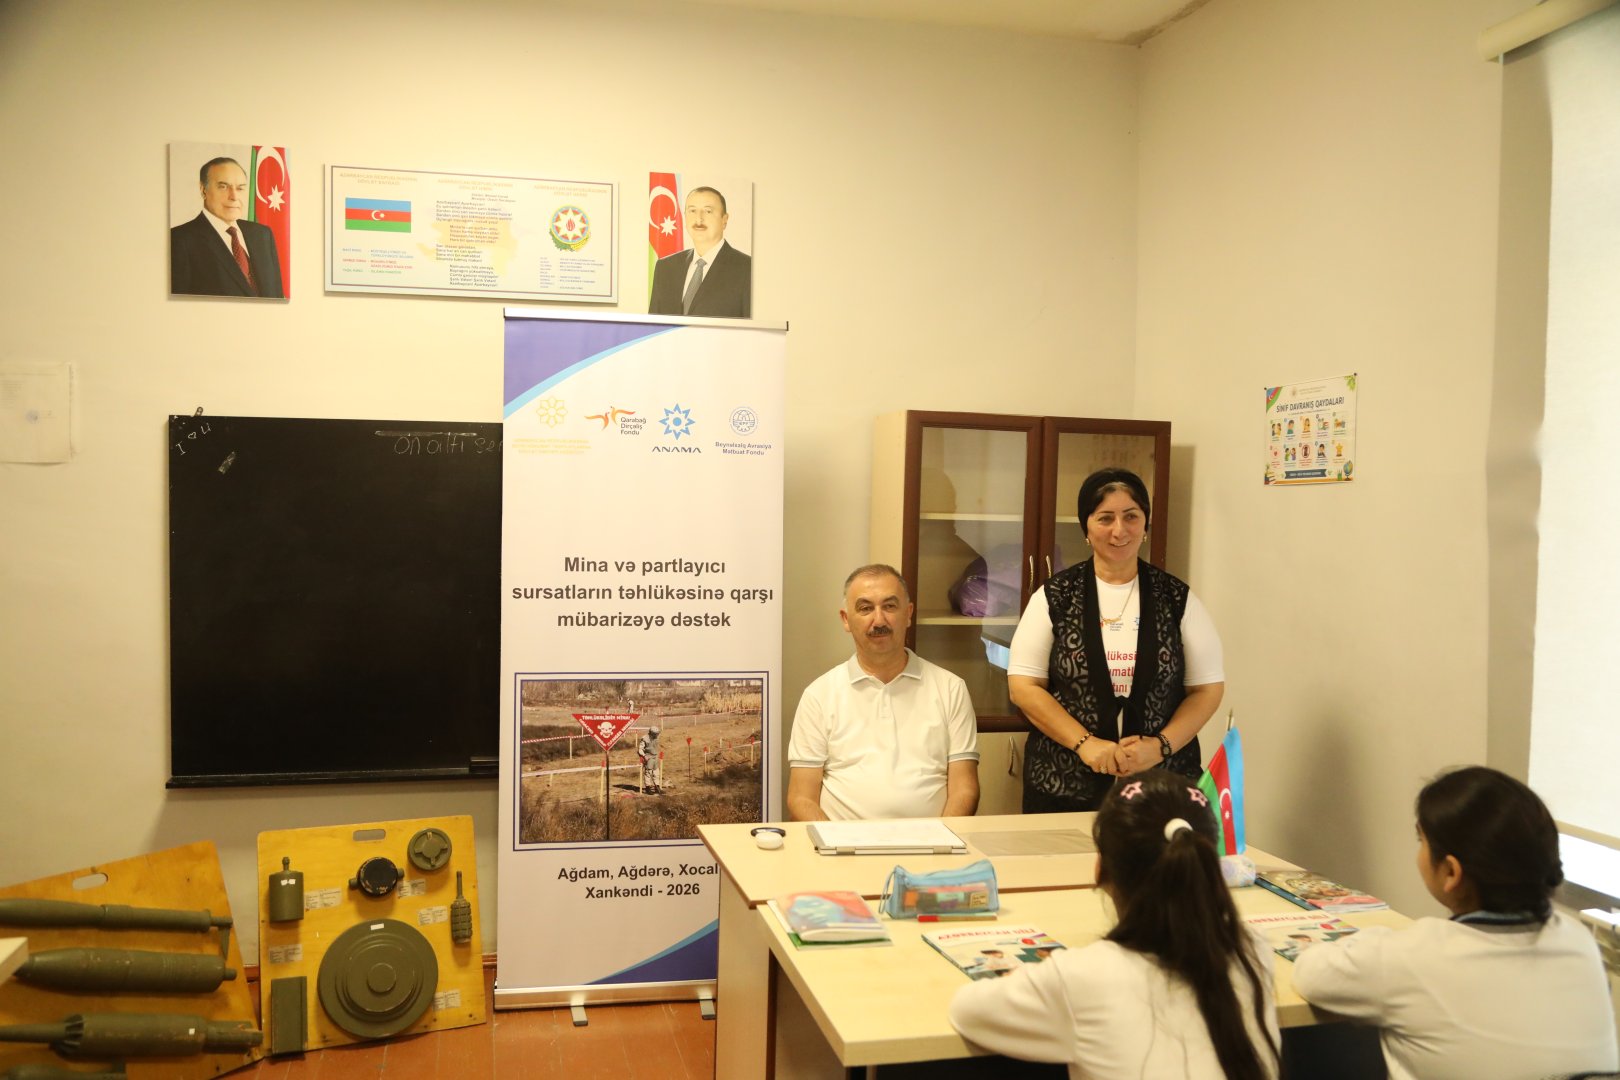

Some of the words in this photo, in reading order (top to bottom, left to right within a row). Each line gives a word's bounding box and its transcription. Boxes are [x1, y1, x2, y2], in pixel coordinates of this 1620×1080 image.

[1290, 400, 1314, 411] DAVRANIŞ
[1315, 396, 1344, 408] QAYDALARI
[564, 556, 608, 572] Mina
[614, 560, 636, 572] və
[642, 558, 726, 576] partlayıcı
[512, 584, 612, 600] sursatların
[618, 584, 724, 600] təhlükəsinə
[730, 588, 773, 604] qarşı
[557, 612, 665, 630] mübarizəyə
[670, 612, 731, 627] dəstək
[557, 867, 614, 882] Ağdam,
[618, 865, 674, 880] Ağdərə,
[679, 863, 718, 876] Xocal
[585, 885, 653, 899] Xankəndi
[666, 883, 700, 896] 2026
